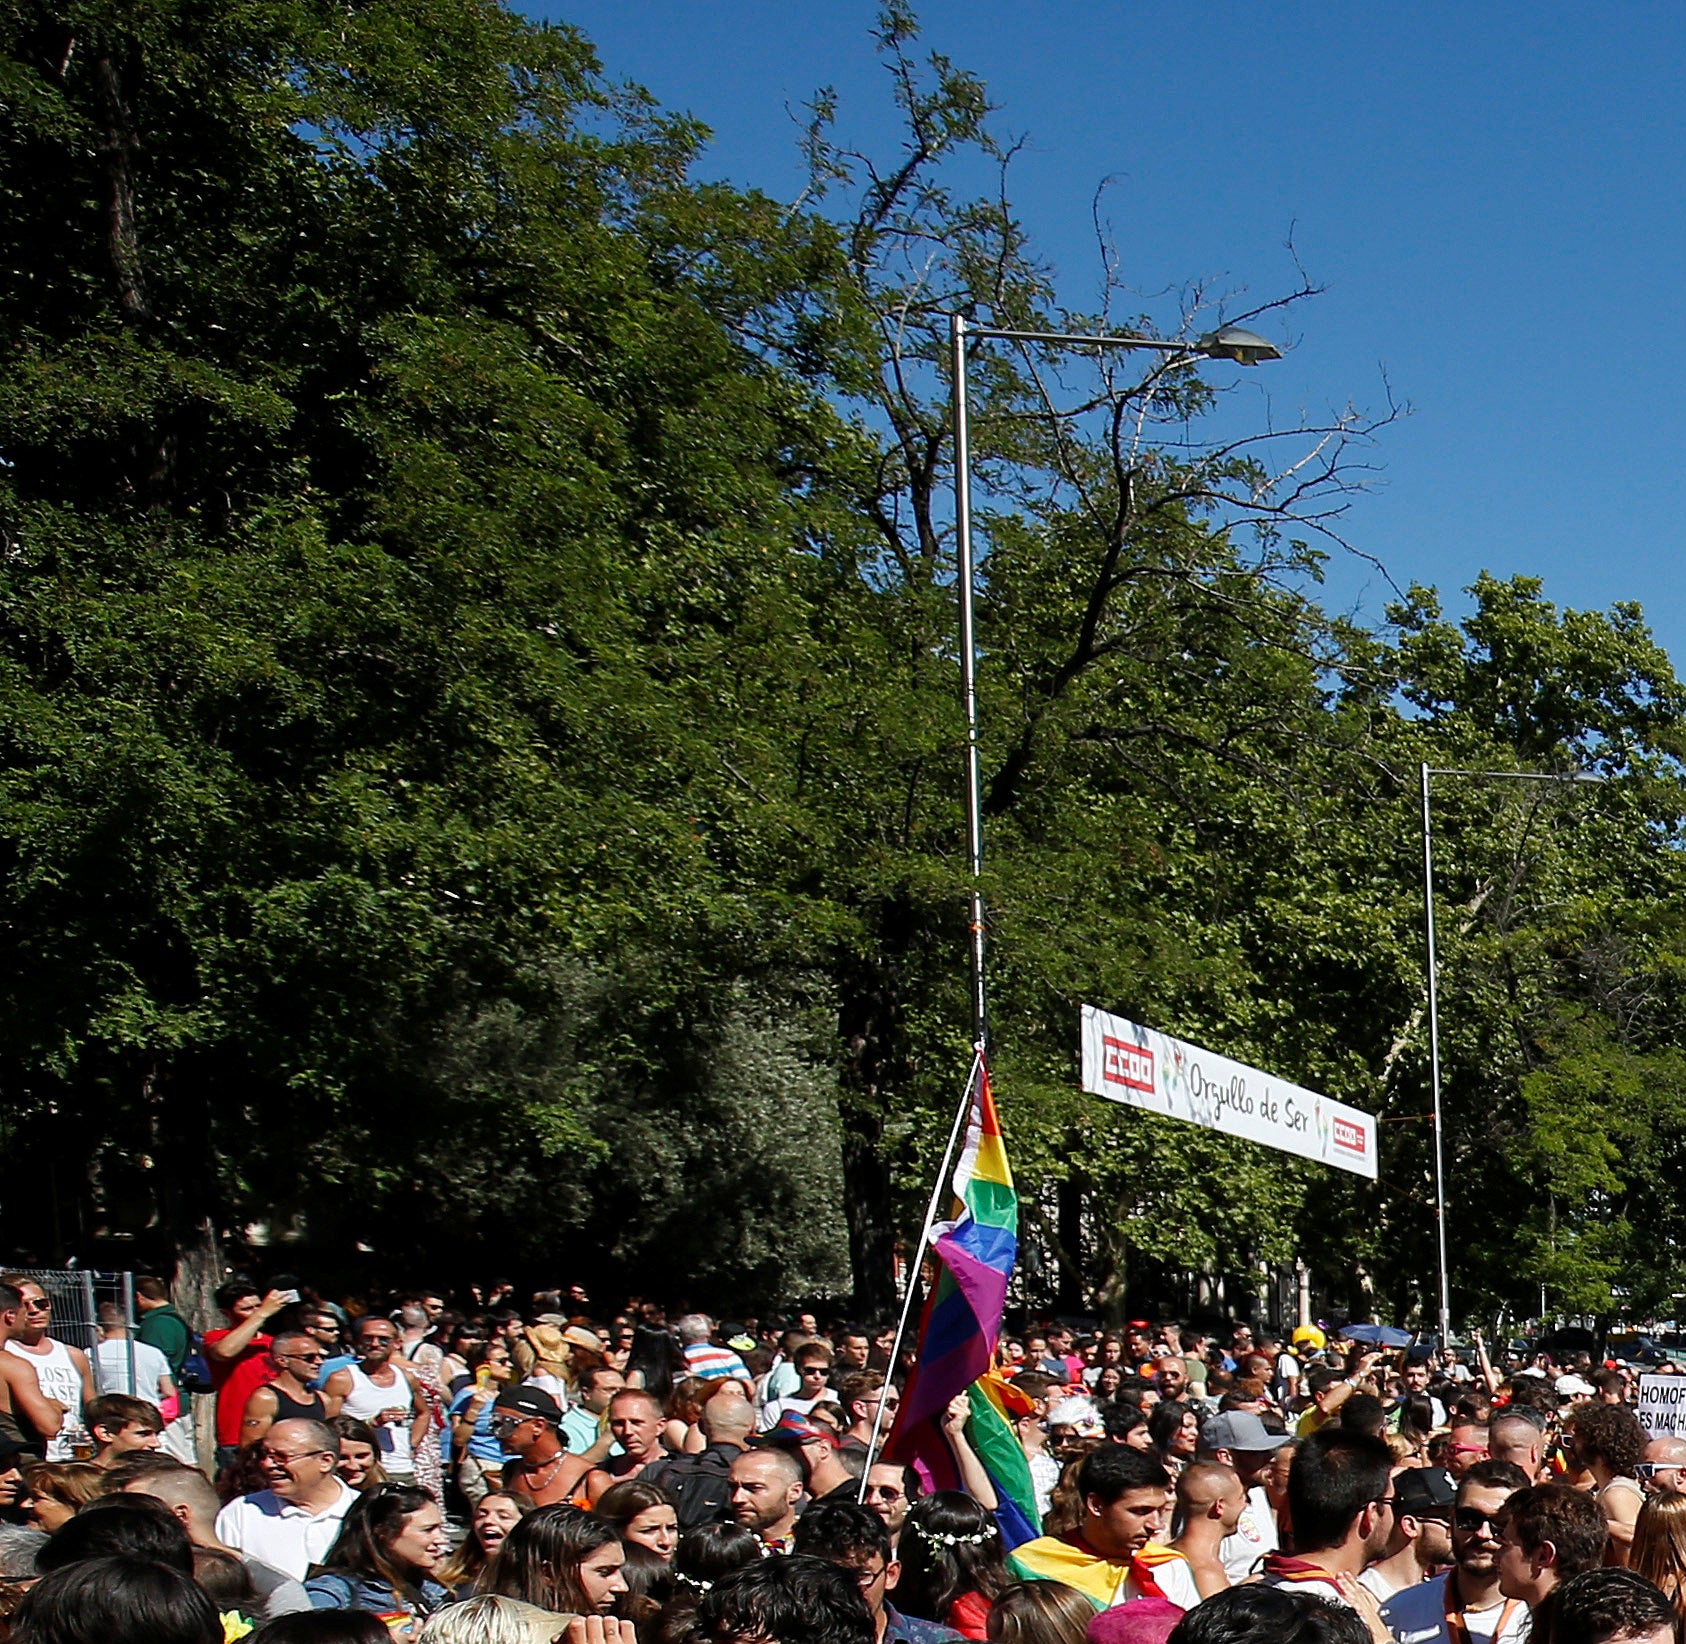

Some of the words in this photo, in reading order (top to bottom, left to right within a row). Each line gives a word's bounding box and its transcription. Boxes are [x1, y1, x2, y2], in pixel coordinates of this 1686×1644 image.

[1190, 1062, 1254, 1122] Orgullo
[1260, 1087, 1278, 1123] de
[1285, 1098, 1308, 1133] Ser
[1640, 1412, 1652, 1429] ES
